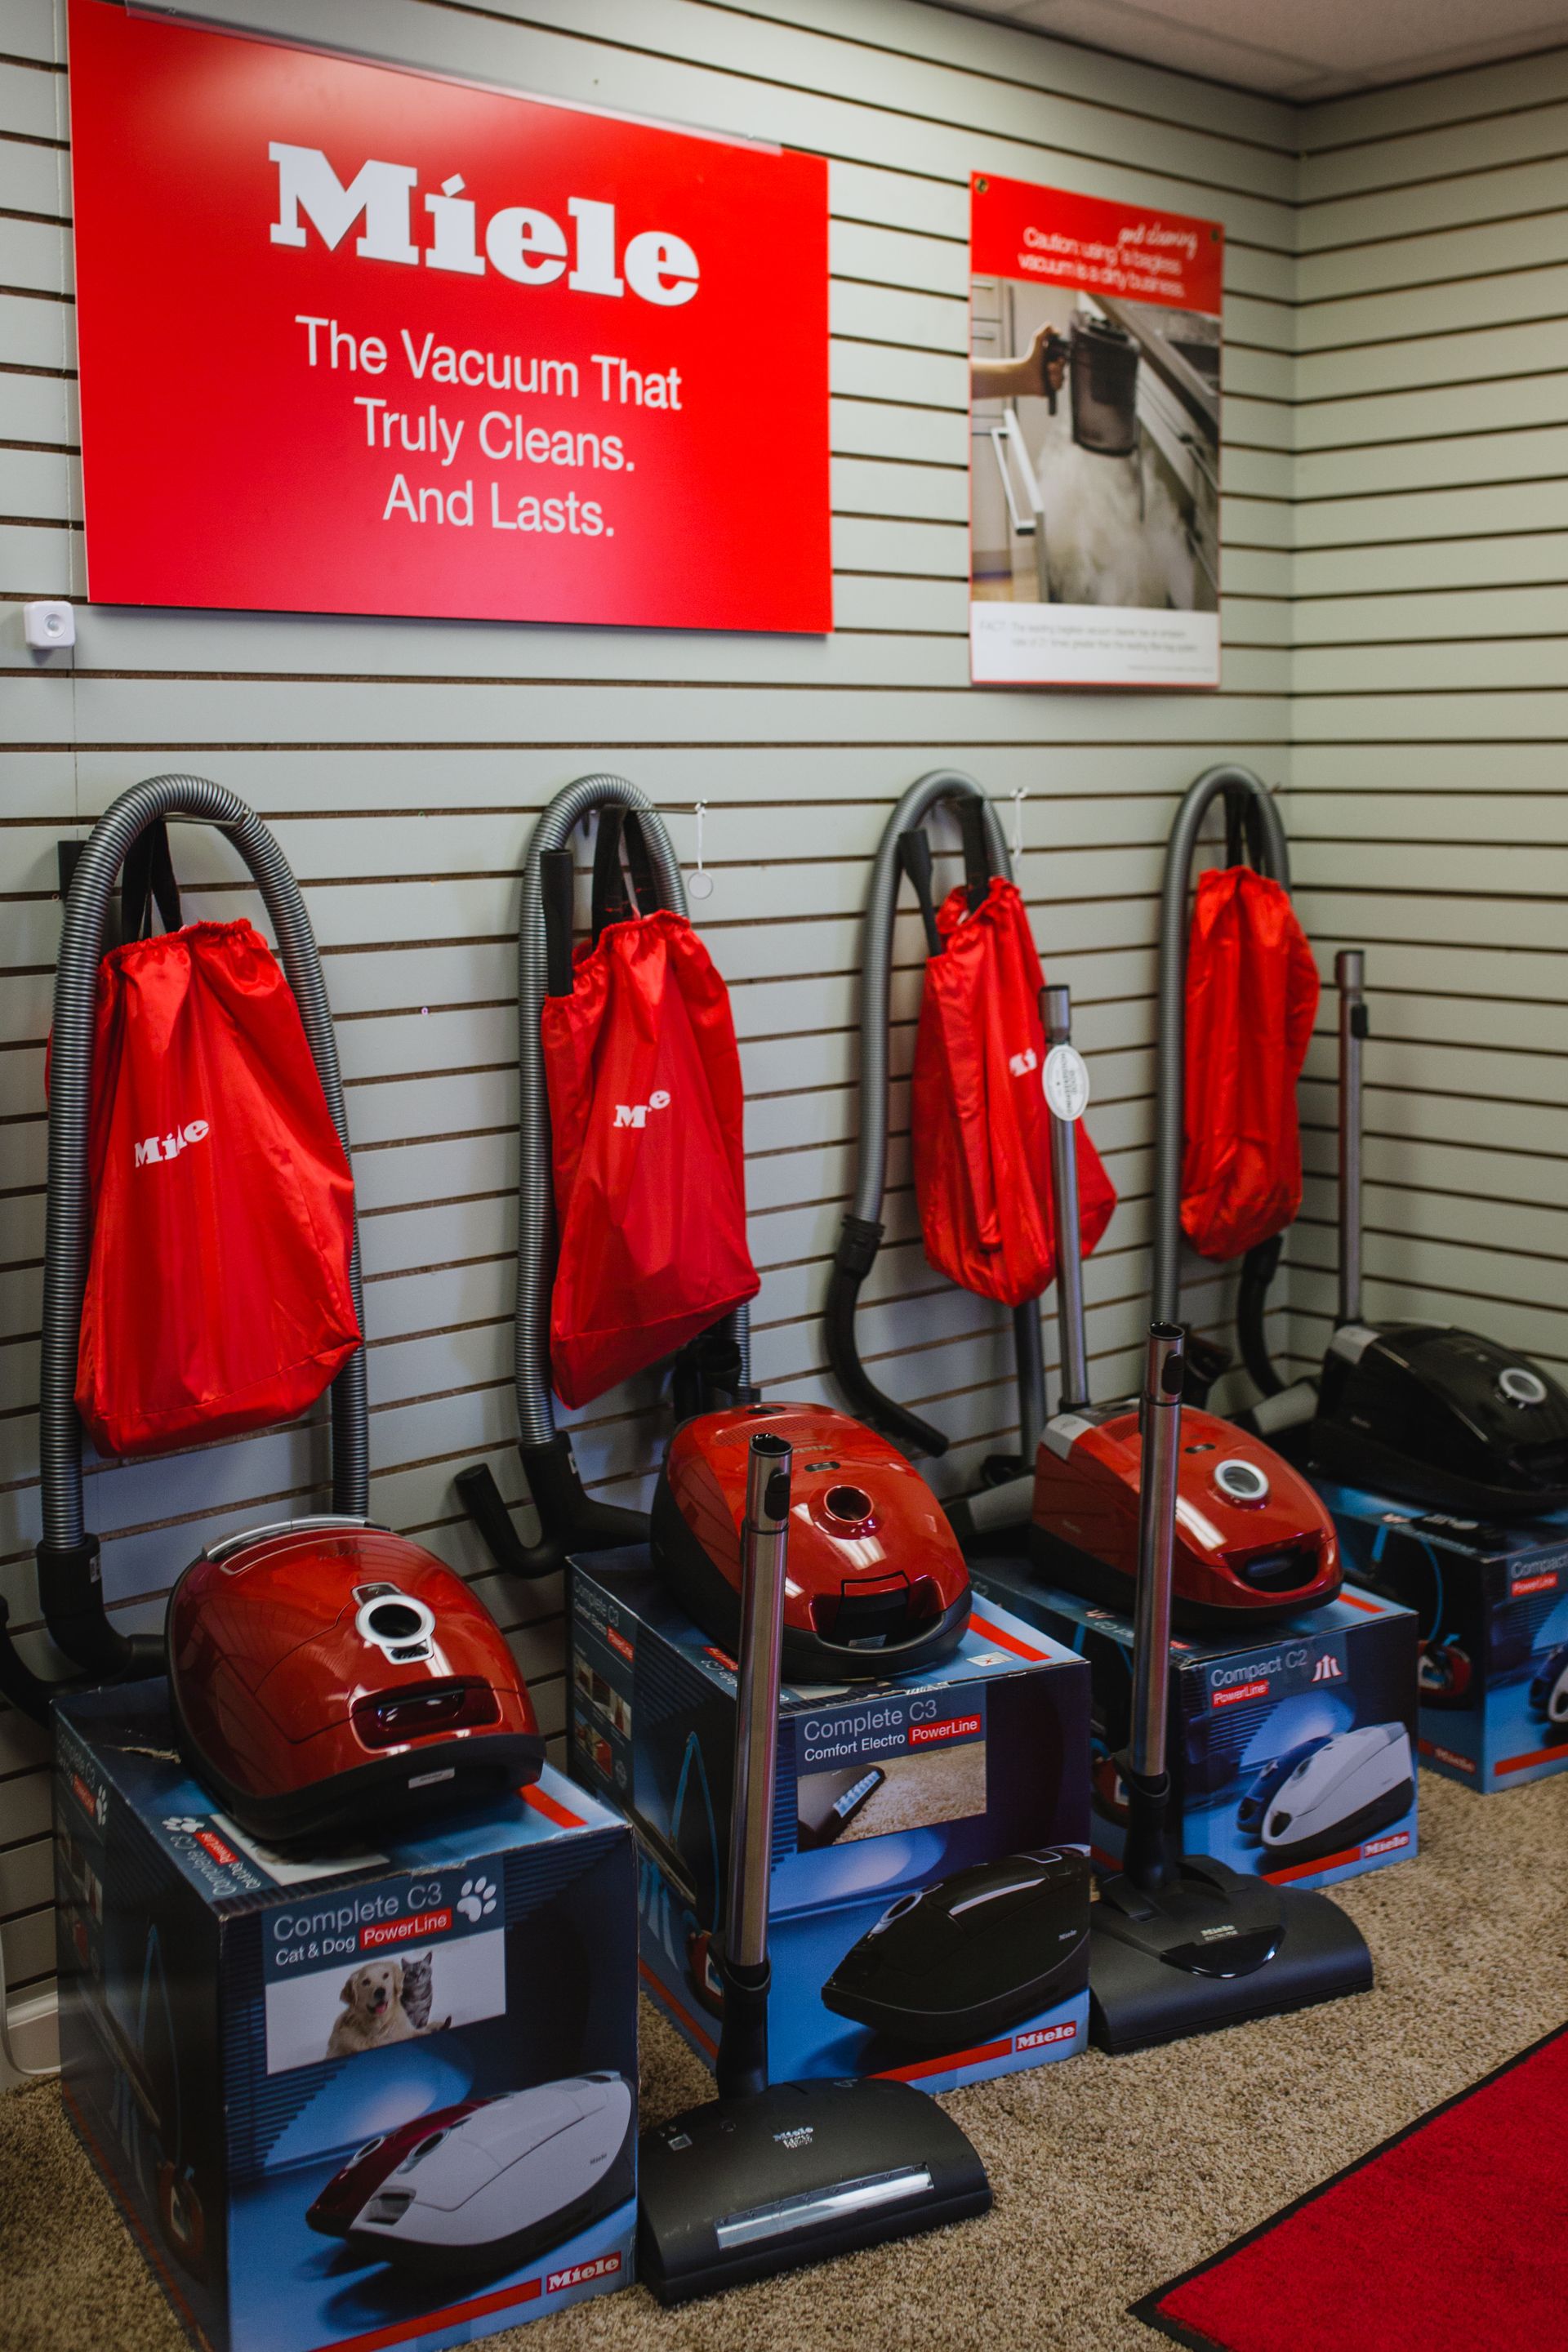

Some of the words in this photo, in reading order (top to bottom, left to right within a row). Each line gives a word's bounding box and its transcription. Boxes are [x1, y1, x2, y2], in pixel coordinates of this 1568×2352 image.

[269, 141, 700, 306] Miele
[1018, 253, 1076, 276] vacuum
[295, 315, 387, 373] The
[401, 329, 578, 397] Vacuum
[590, 354, 683, 410] That
[354, 397, 464, 466] Truly
[479, 411, 635, 471] Cleans.
[383, 474, 474, 526] And
[490, 482, 614, 537] Lasts.
[1210, 1656, 1282, 1686] Compact
[1285, 1649, 1307, 1668] C2
[1214, 1684, 1266, 1704] PowerLine
[804, 1708, 903, 1741] Complete
[909, 1699, 938, 1722] C3
[804, 1741, 858, 1762] Comfort
[862, 1733, 905, 1752] Electro
[912, 1718, 978, 1741] PowerLine
[1365, 1836, 1409, 1857] Miele
[274, 1894, 399, 1941] Complete
[408, 1882, 443, 1910] C3
[275, 1947, 305, 1967] Cat
[307, 1941, 318, 1958] &
[323, 1936, 356, 1955] Dog
[363, 1912, 448, 1945] PowerLine
[1017, 2024, 1075, 2050] Miele
[548, 2256, 620, 2292] Miele
